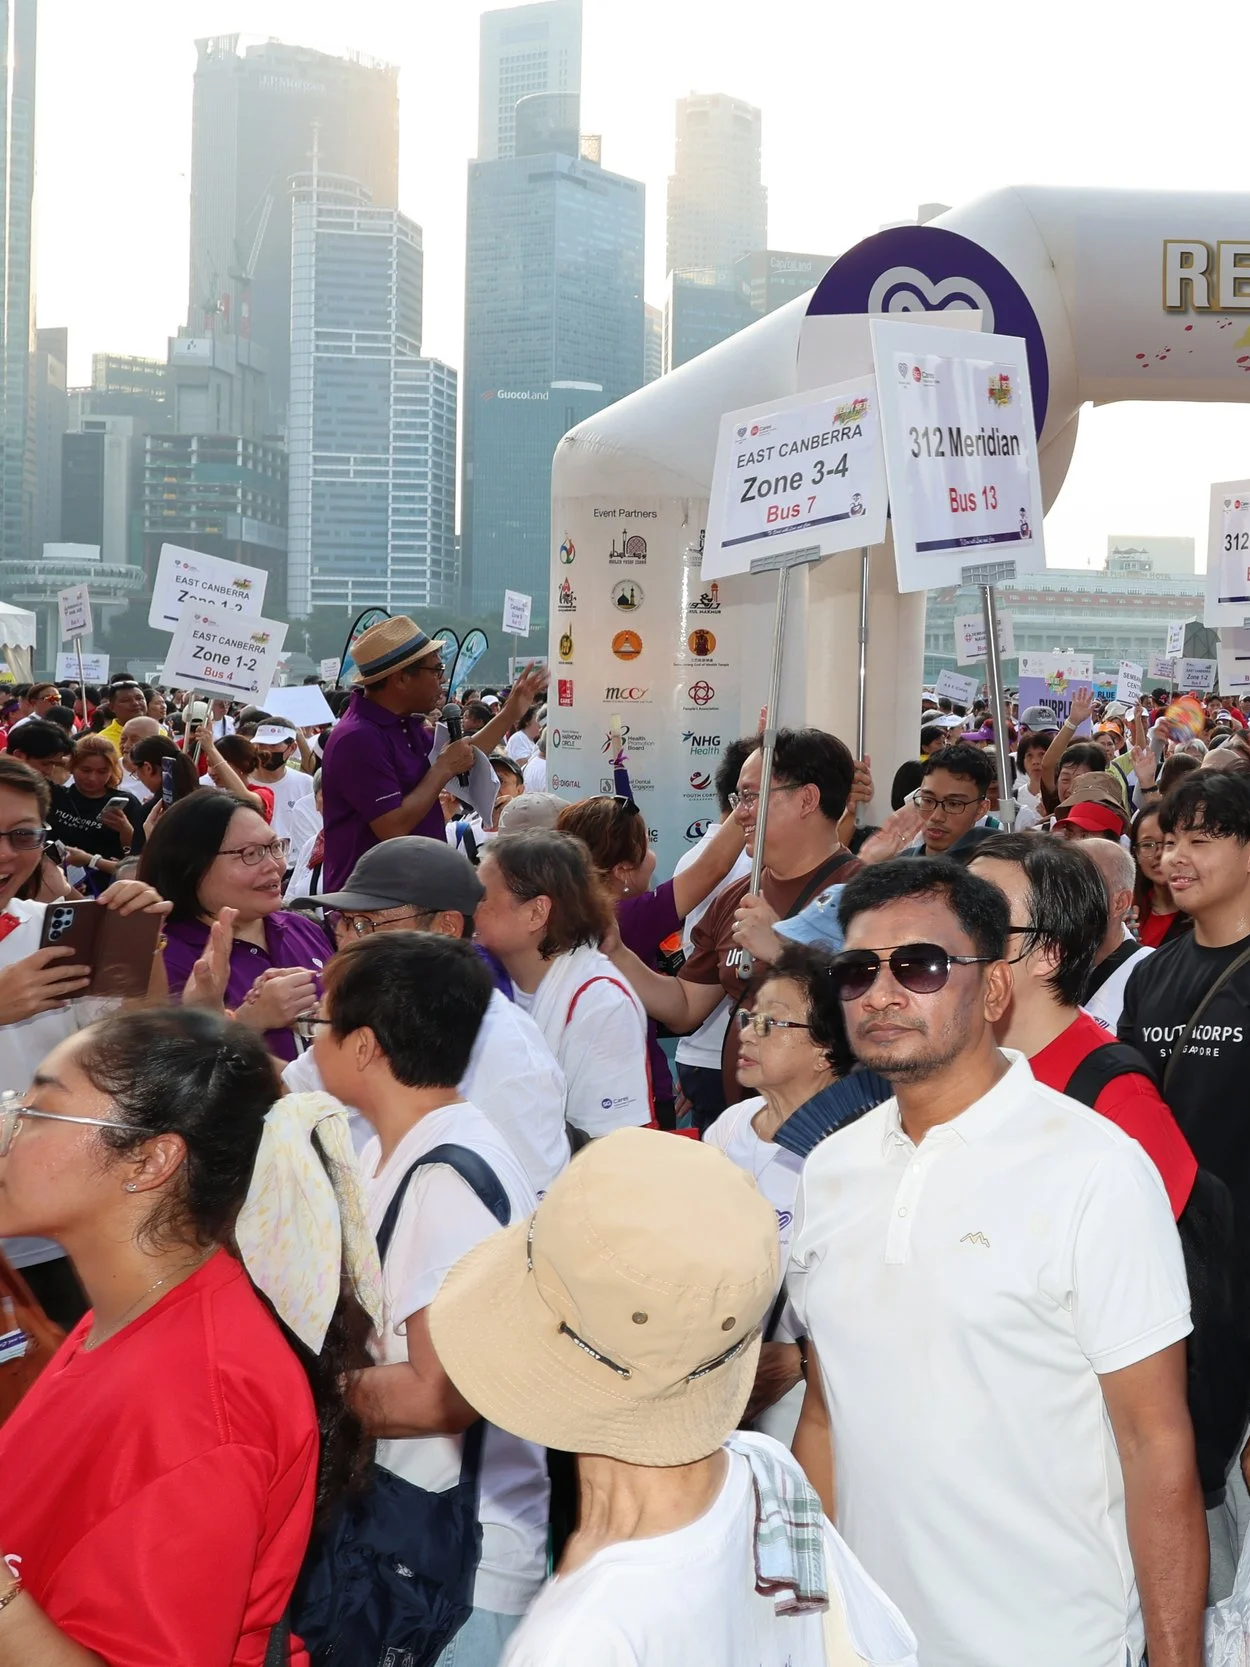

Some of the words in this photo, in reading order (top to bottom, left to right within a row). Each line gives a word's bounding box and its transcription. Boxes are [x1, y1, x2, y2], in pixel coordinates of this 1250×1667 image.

[497, 389, 549, 401] GuocoLand
[737, 446, 775, 469] EAST
[778, 424, 863, 458] CANBERRA
[909, 426, 945, 458] 312
[948, 427, 1021, 457] Meridian
[740, 471, 803, 503] Zone
[811, 453, 849, 486] 3-4
[949, 487, 977, 513] Bus
[982, 486, 998, 511] 13
[594, 508, 617, 518] Event
[618, 508, 658, 519] Partners
[767, 503, 800, 523] Bus
[807, 496, 817, 514] 7
[1225, 532, 1250, 551] 312
[175, 575, 200, 587] EAST
[201, 581, 250, 600] CANBERRA
[192, 630, 217, 642] EAST
[218, 636, 266, 654] CANBERRA
[192, 645, 231, 665] Zone
[236, 656, 257, 672] 1-2
[204, 667, 224, 679] Bus
[227, 672, 234, 680] 4
[1097, 691, 1115, 699] BLUE
[1128, 690, 1140, 699] ZON
[691, 735, 720, 747] NHG
[690, 747, 720, 755] Health
[561, 780, 581, 788] DIGITAL
[1142, 1024, 1195, 1042] YOUT
[1197, 1025, 1243, 1042] CORPS
[1160, 1045, 1220, 1057] SIGAPORE
